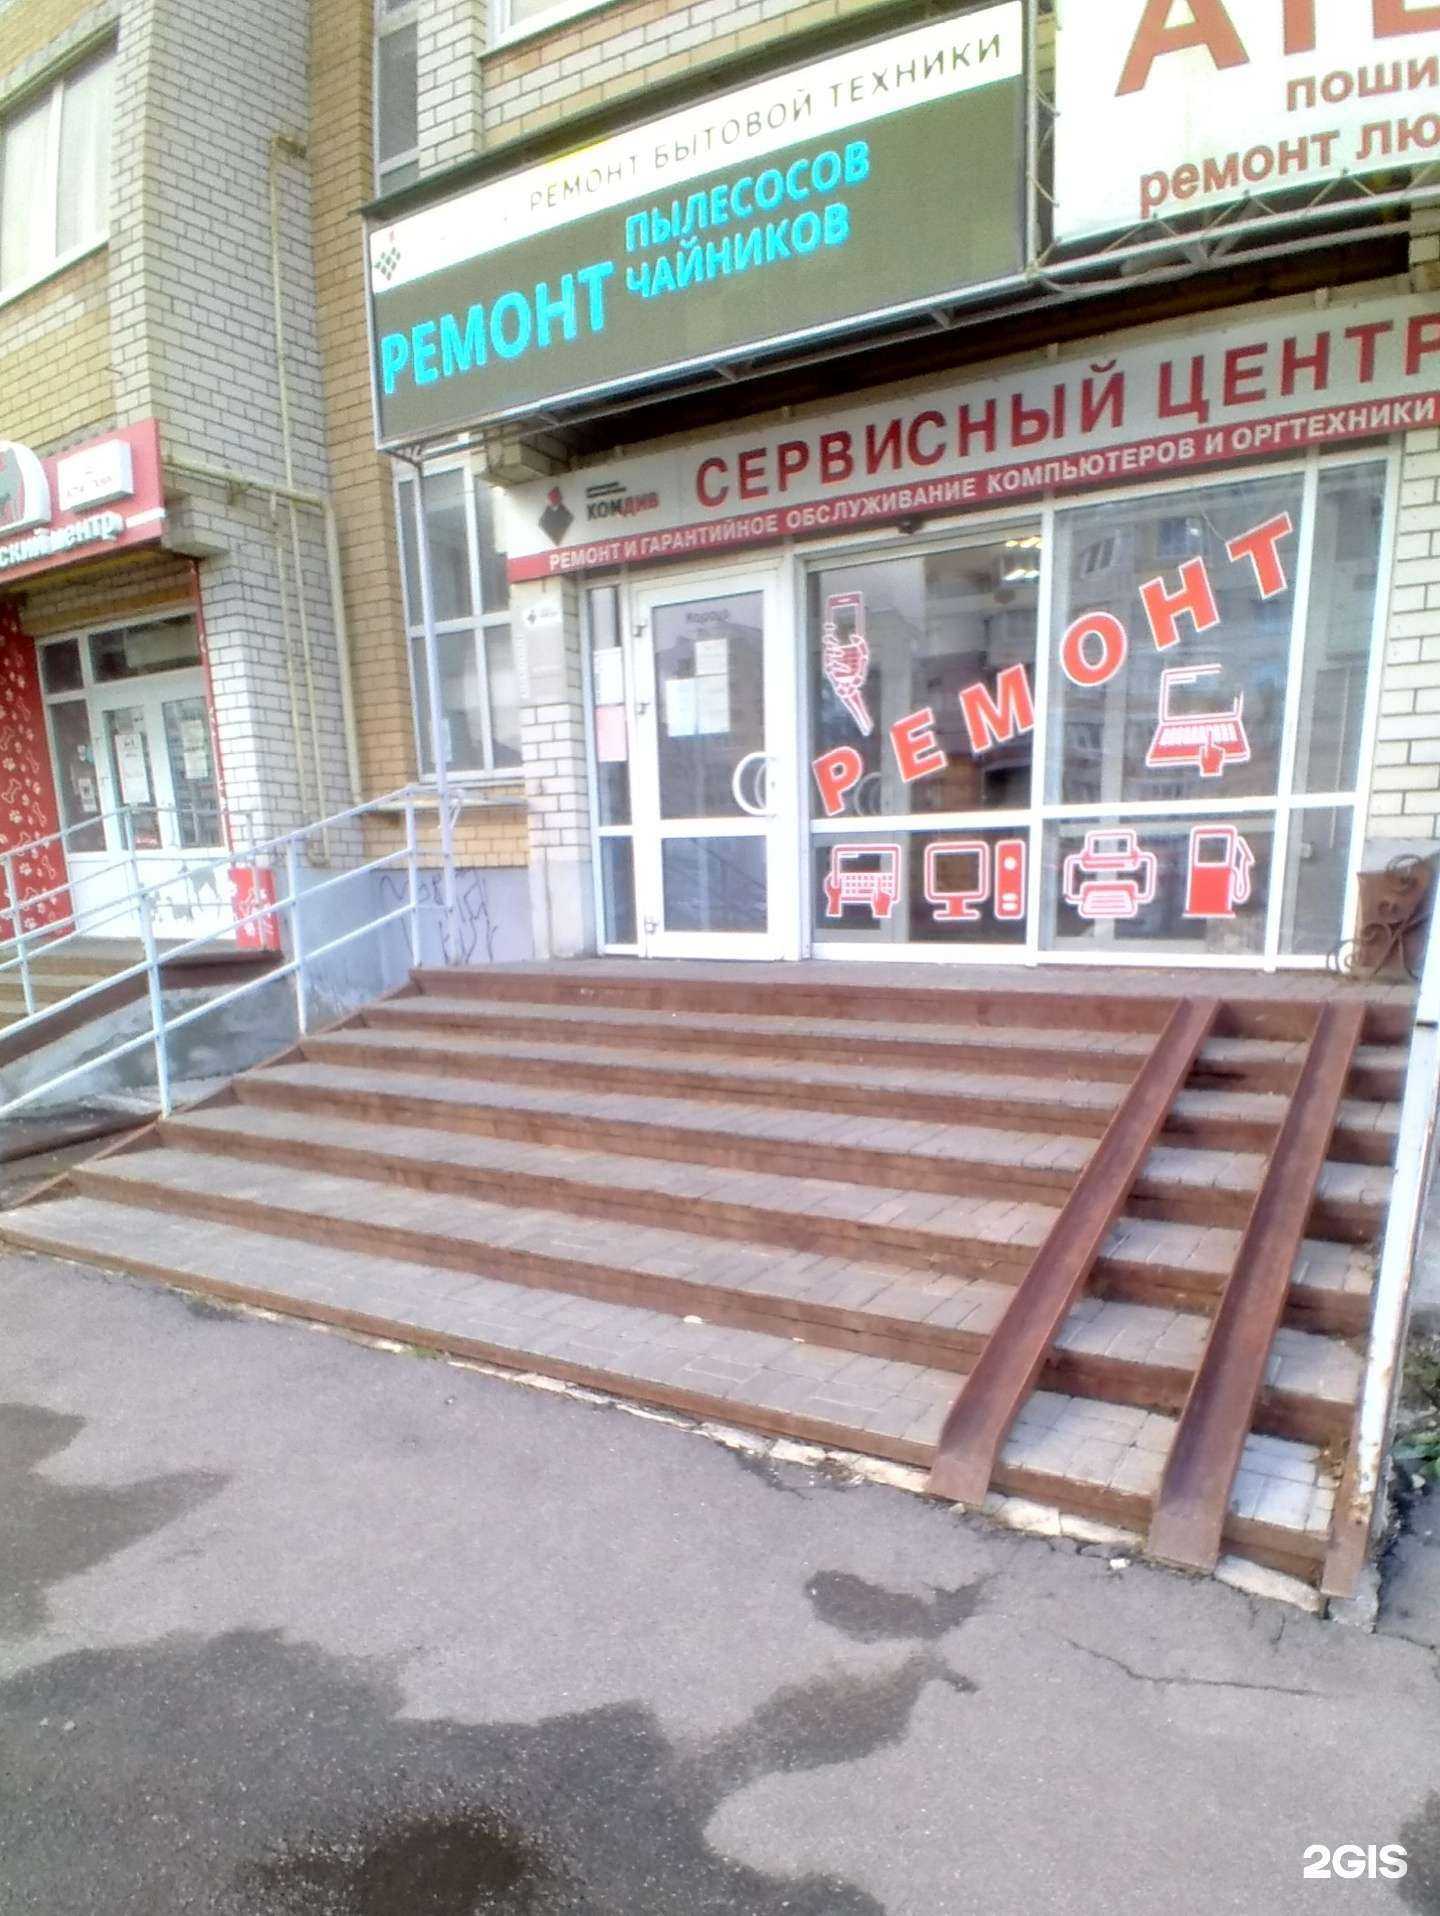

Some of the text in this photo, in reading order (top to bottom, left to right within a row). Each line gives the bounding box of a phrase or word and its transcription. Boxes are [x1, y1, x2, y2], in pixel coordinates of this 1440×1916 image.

[530, 33, 1002, 212] РЕМОНТ БЫТОВОЙ ТЕХНИКИ
[624, 139, 870, 253] ПЫЛЕСОСОВ
[1139, 129, 1341, 220] ремонт
[625, 201, 851, 299] ЧАЙНИКОВ
[380, 260, 615, 395] РЕМОНТ
[549, 397, 1437, 571] РЕМОНТ И ГАРАНТИЙНОЕ ОБСЛУЖИВАНИЕ КОМПЬЮТЕРОВ И ОРГТЕХНИКИ
[695, 312, 1440, 508] СЕРВИСНЫЙ ЦЕНТР
[812, 511, 1293, 816] РЕМОНТ
